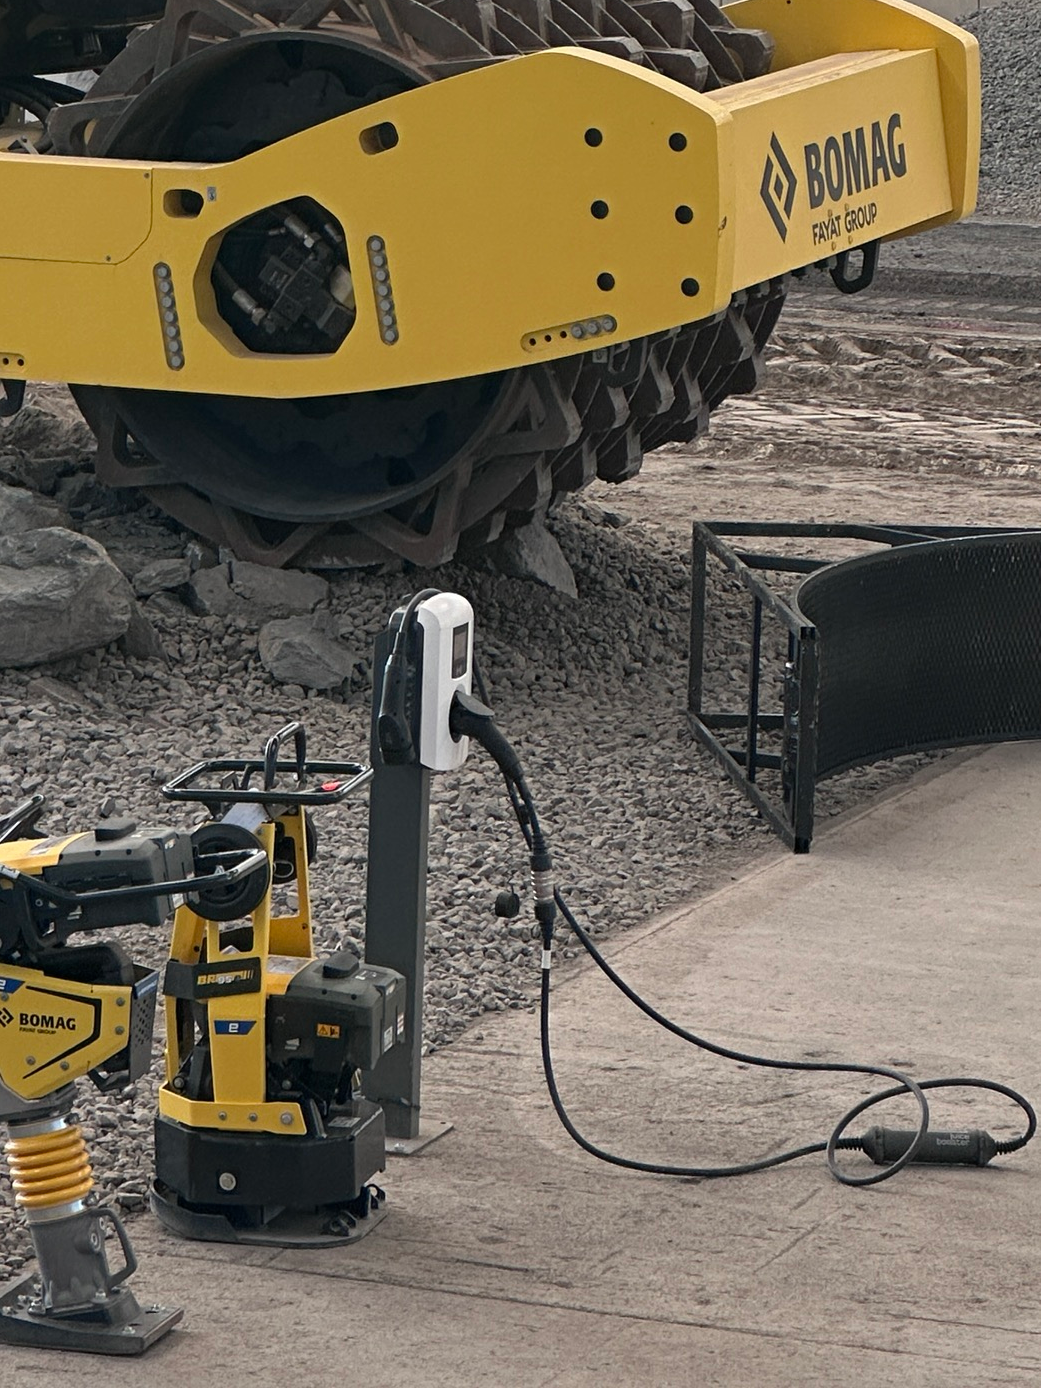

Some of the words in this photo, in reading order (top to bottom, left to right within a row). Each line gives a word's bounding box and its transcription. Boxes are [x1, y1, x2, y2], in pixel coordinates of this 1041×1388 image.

[804, 112, 908, 210] BOMAG
[812, 214, 842, 246] FAYAT
[844, 202, 878, 233] GROUP
[19, 1013, 77, 1031] BOMAG
